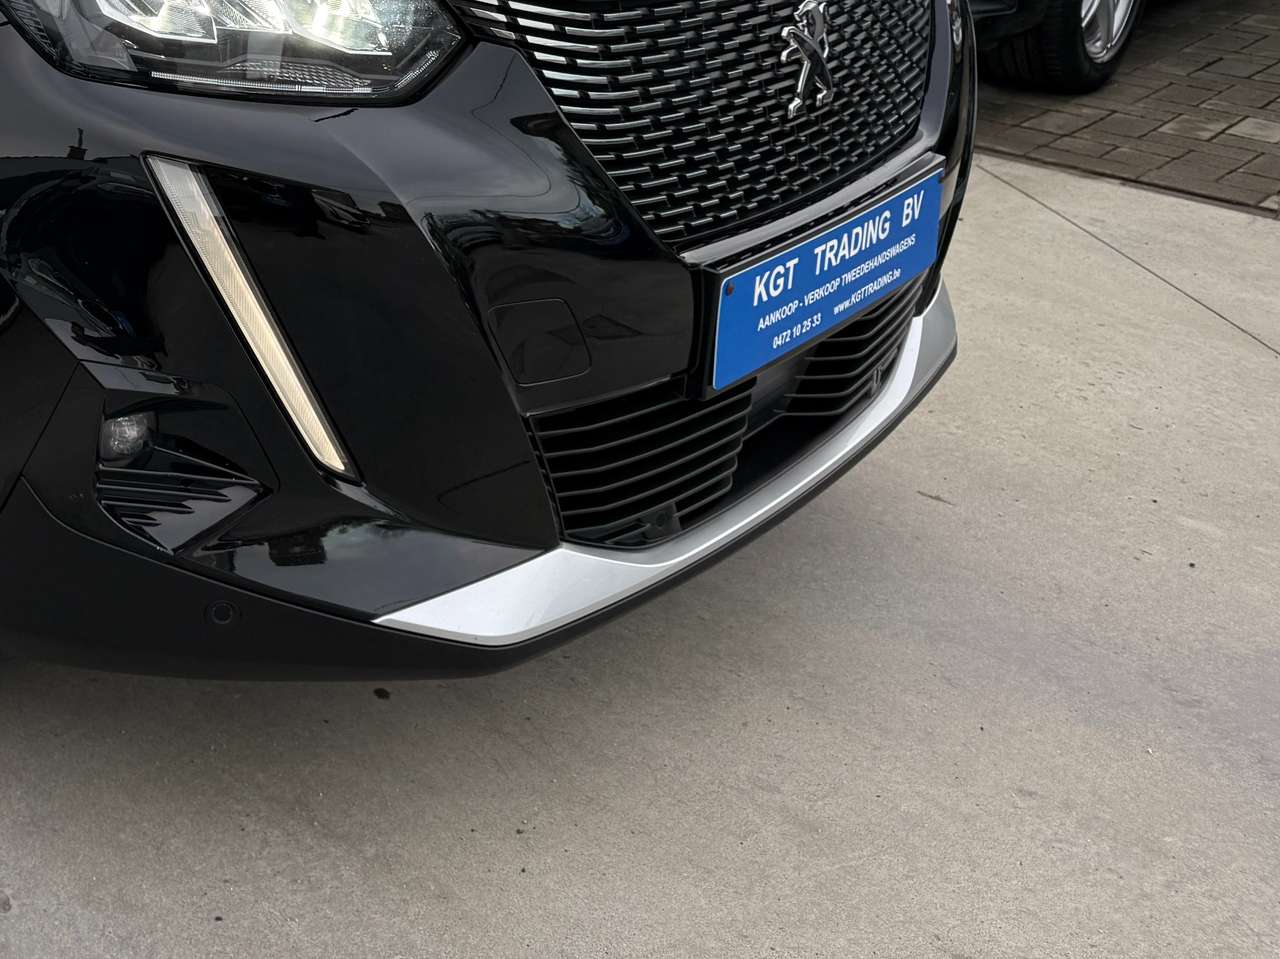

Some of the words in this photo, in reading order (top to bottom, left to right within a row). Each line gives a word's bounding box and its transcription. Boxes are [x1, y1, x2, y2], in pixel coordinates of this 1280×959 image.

[753, 258, 800, 307] KGT
[814, 210, 892, 275] TRADING
[902, 190, 924, 227] BV
[757, 300, 799, 332] AANKOOP
[804, 278, 841, 308] VERKOOP
[841, 234, 916, 287] TWEEDEHANDSWAGENS
[833, 268, 902, 316] www.KGTTRADING.be
[773, 332, 791, 349] 0472
[793, 325, 802, 339] 10
[802, 319, 812, 334] 25
[812, 313, 822, 327] 33
